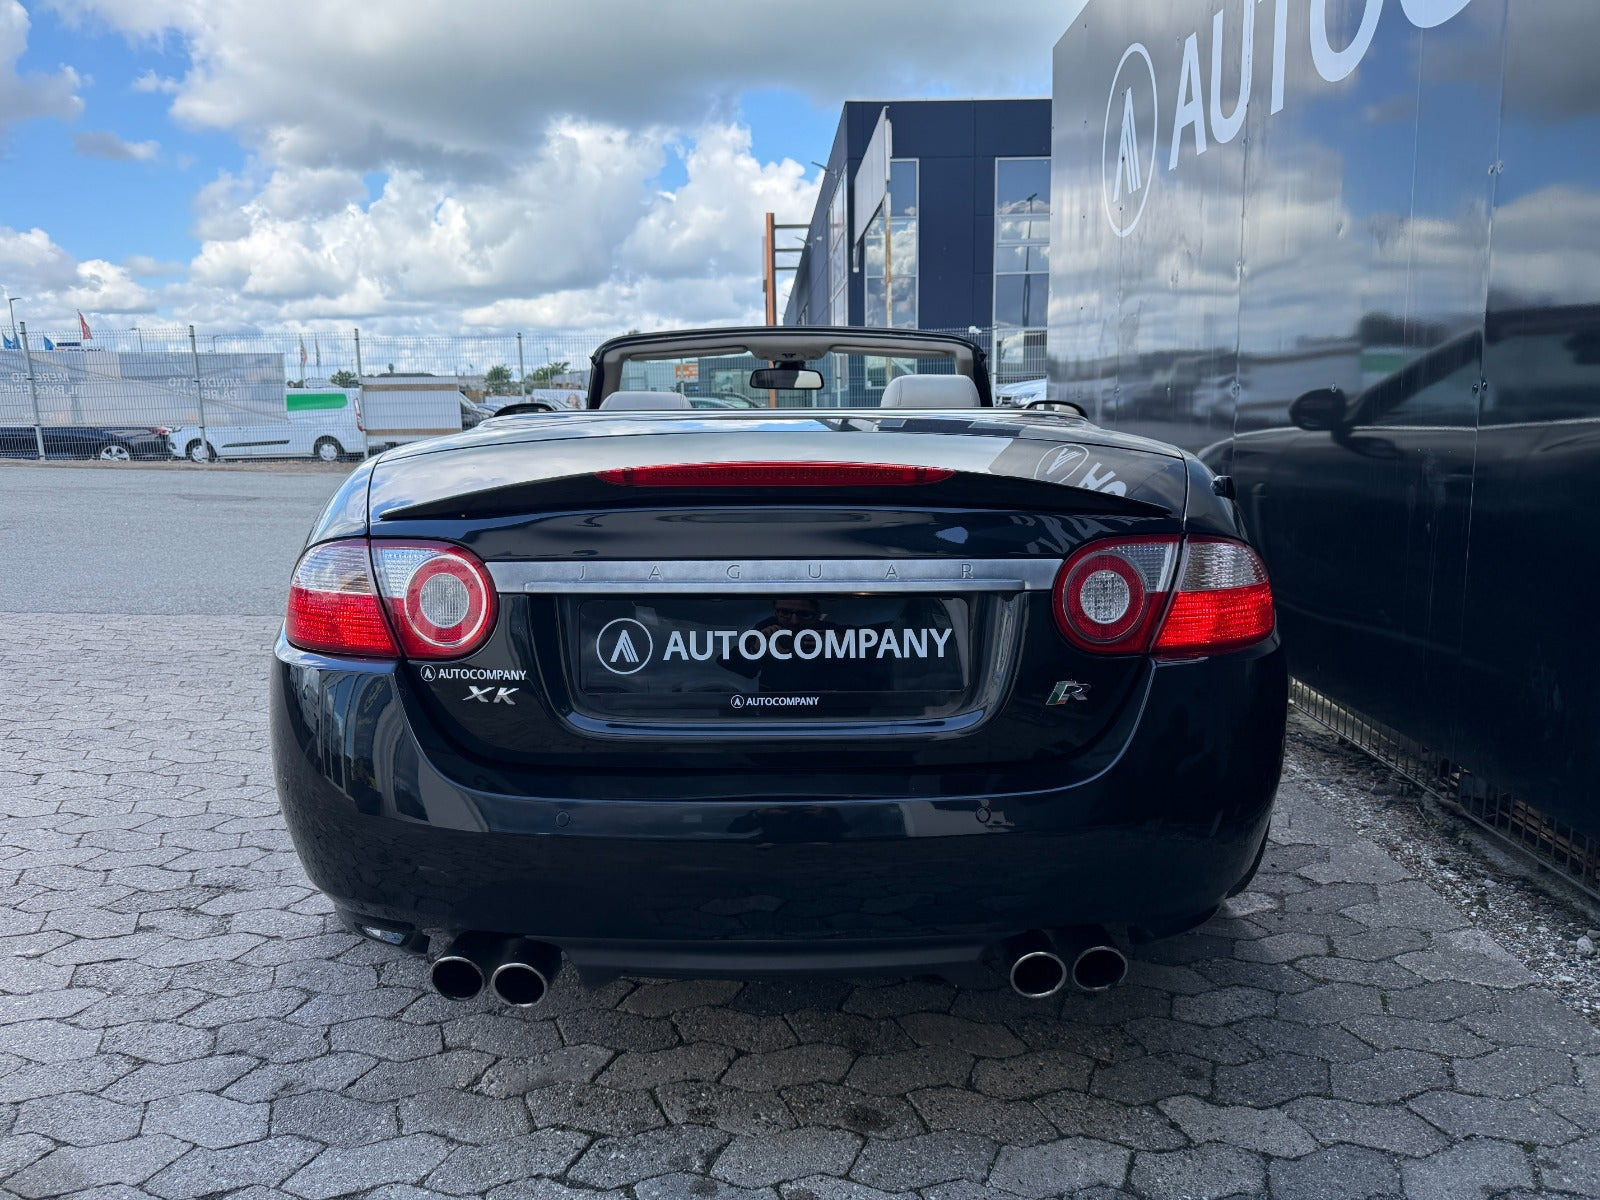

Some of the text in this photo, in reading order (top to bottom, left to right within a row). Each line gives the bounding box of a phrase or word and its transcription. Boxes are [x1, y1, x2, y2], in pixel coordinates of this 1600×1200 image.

[1168, 0, 1475, 171] AUTO
[578, 563, 975, 581] JAGUAR
[663, 627, 952, 662] AUTOCOMPANY
[438, 668, 527, 681] AUTOCOMPANY
[462, 685, 520, 705] XK
[746, 696, 820, 706] AUTOCOMPANY
